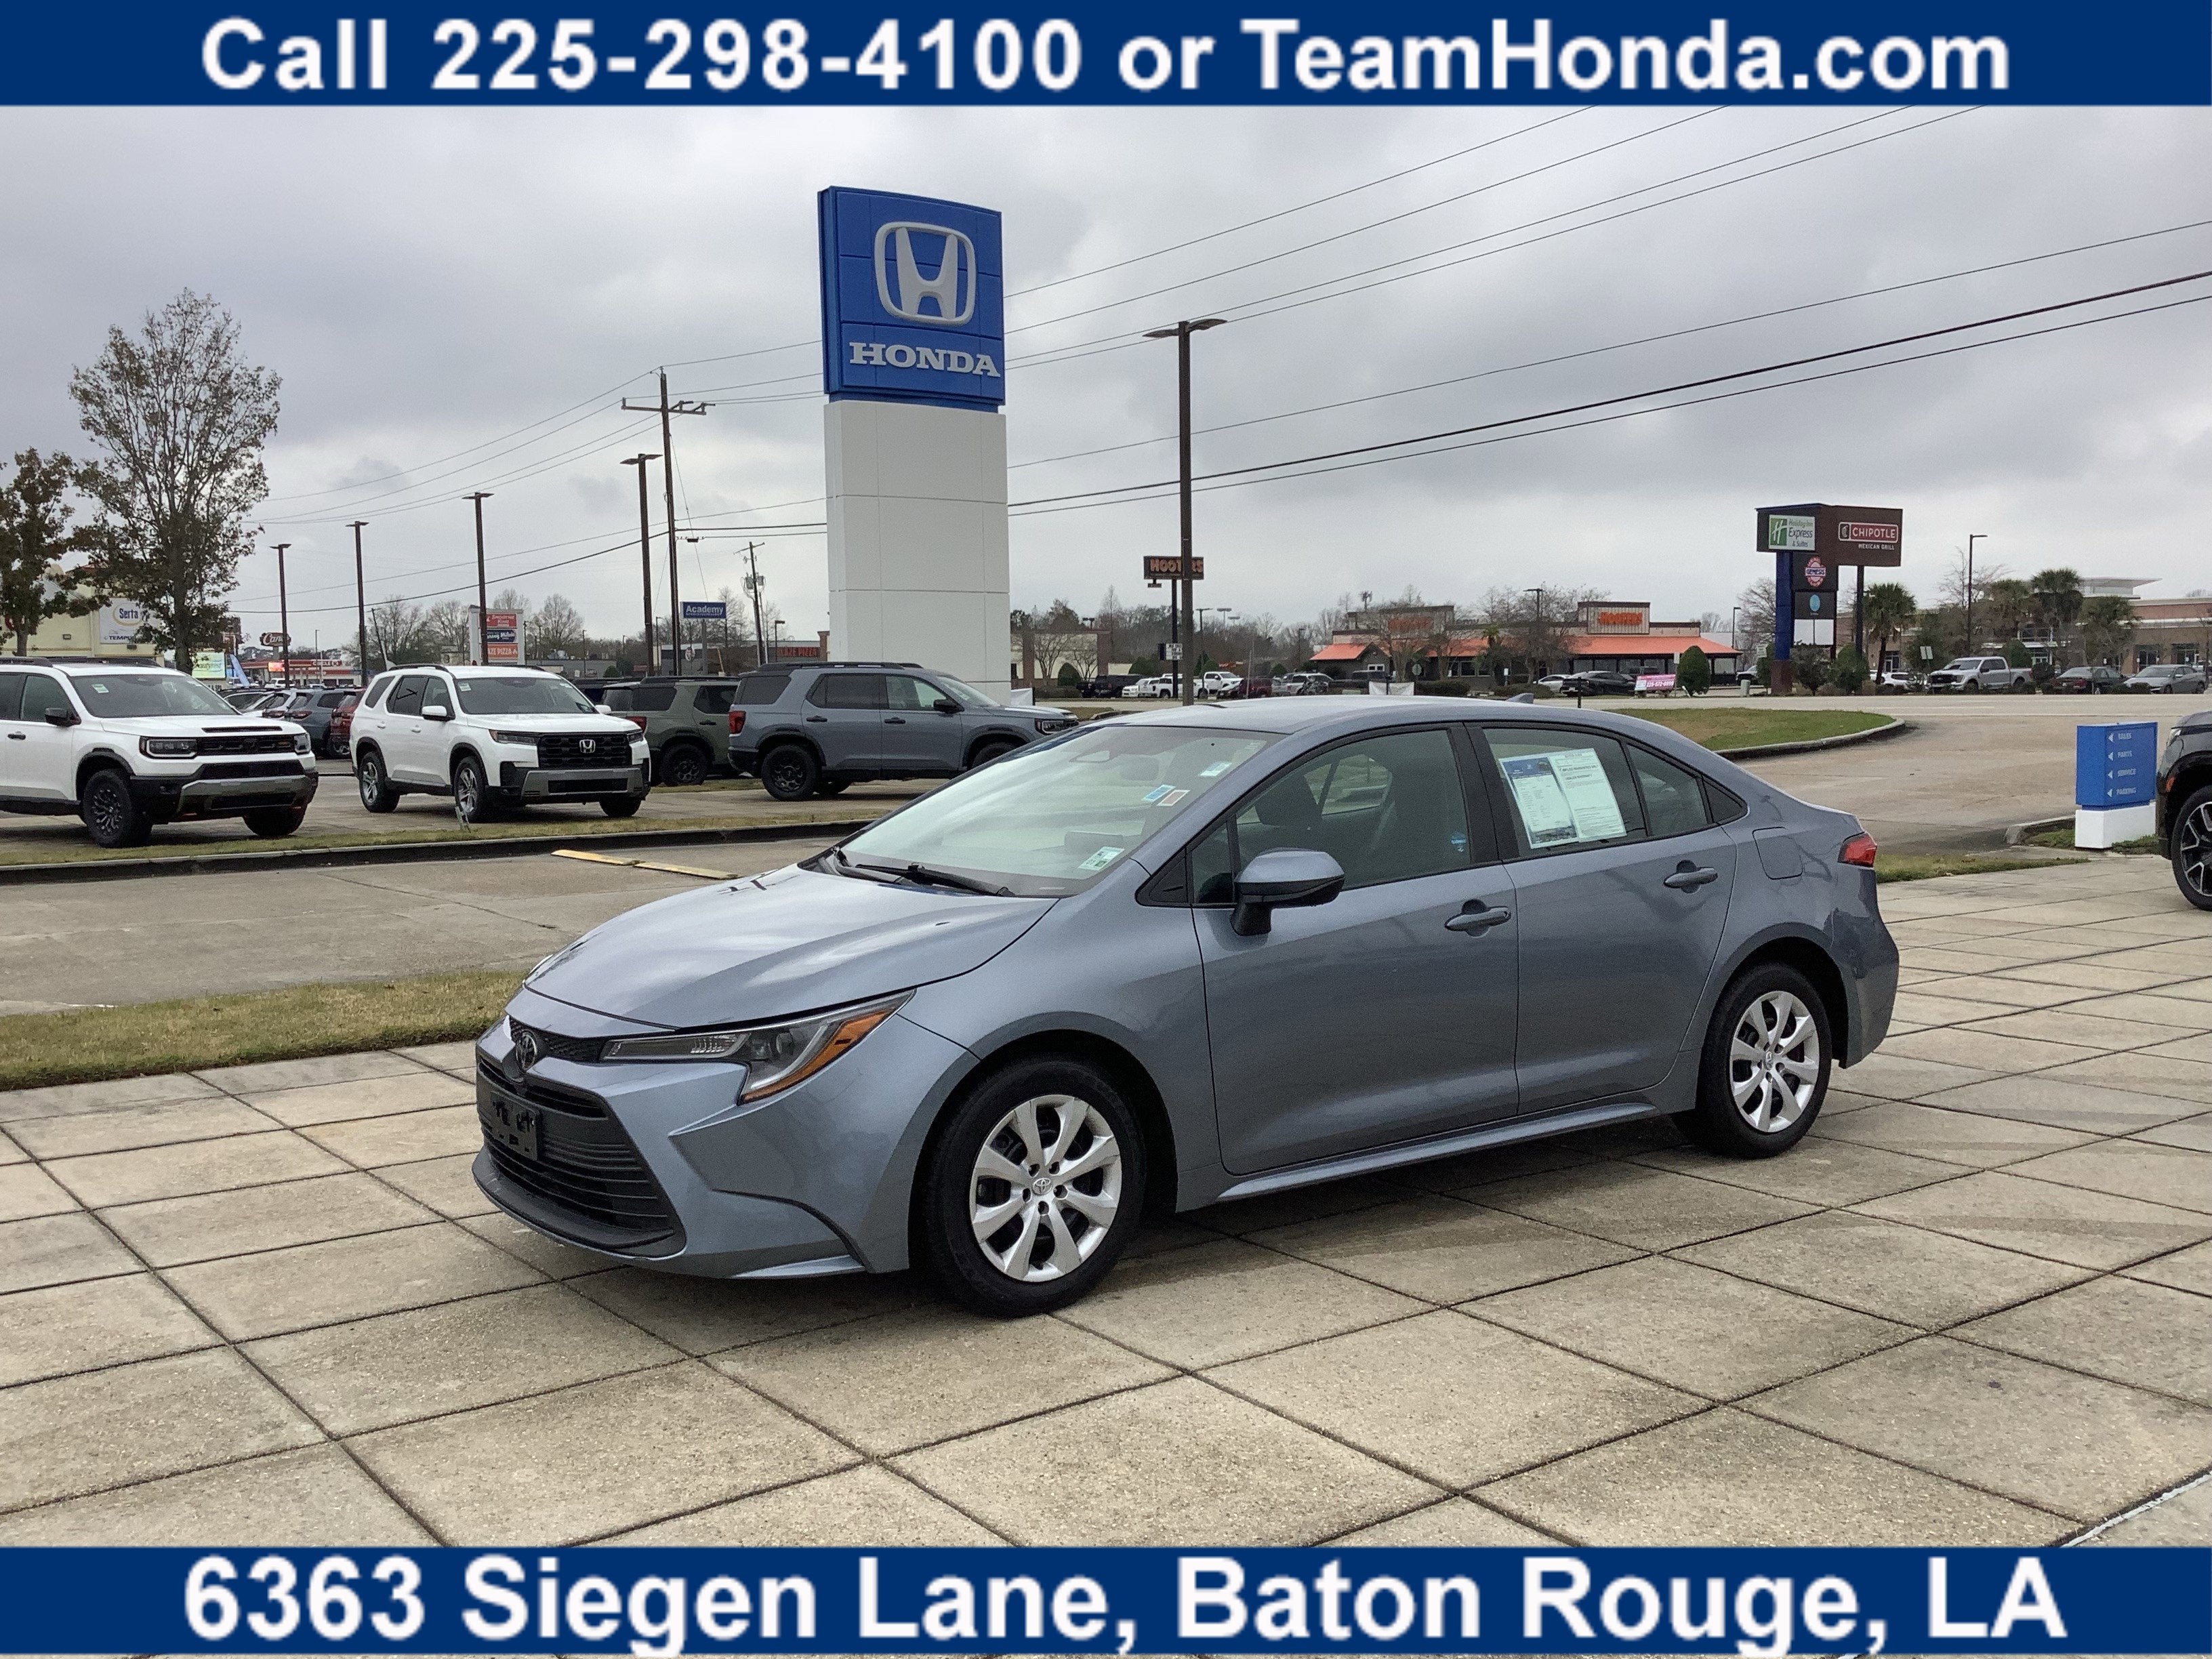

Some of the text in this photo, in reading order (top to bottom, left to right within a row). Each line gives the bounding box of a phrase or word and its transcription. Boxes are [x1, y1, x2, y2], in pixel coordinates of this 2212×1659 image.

[849, 342, 1001, 377] HONDA
[1788, 527, 1813, 539] Express
[1852, 527, 1896, 538] CHIPOTLE
[119, 608, 138, 619] Serta
[685, 605, 724, 615] Academy
